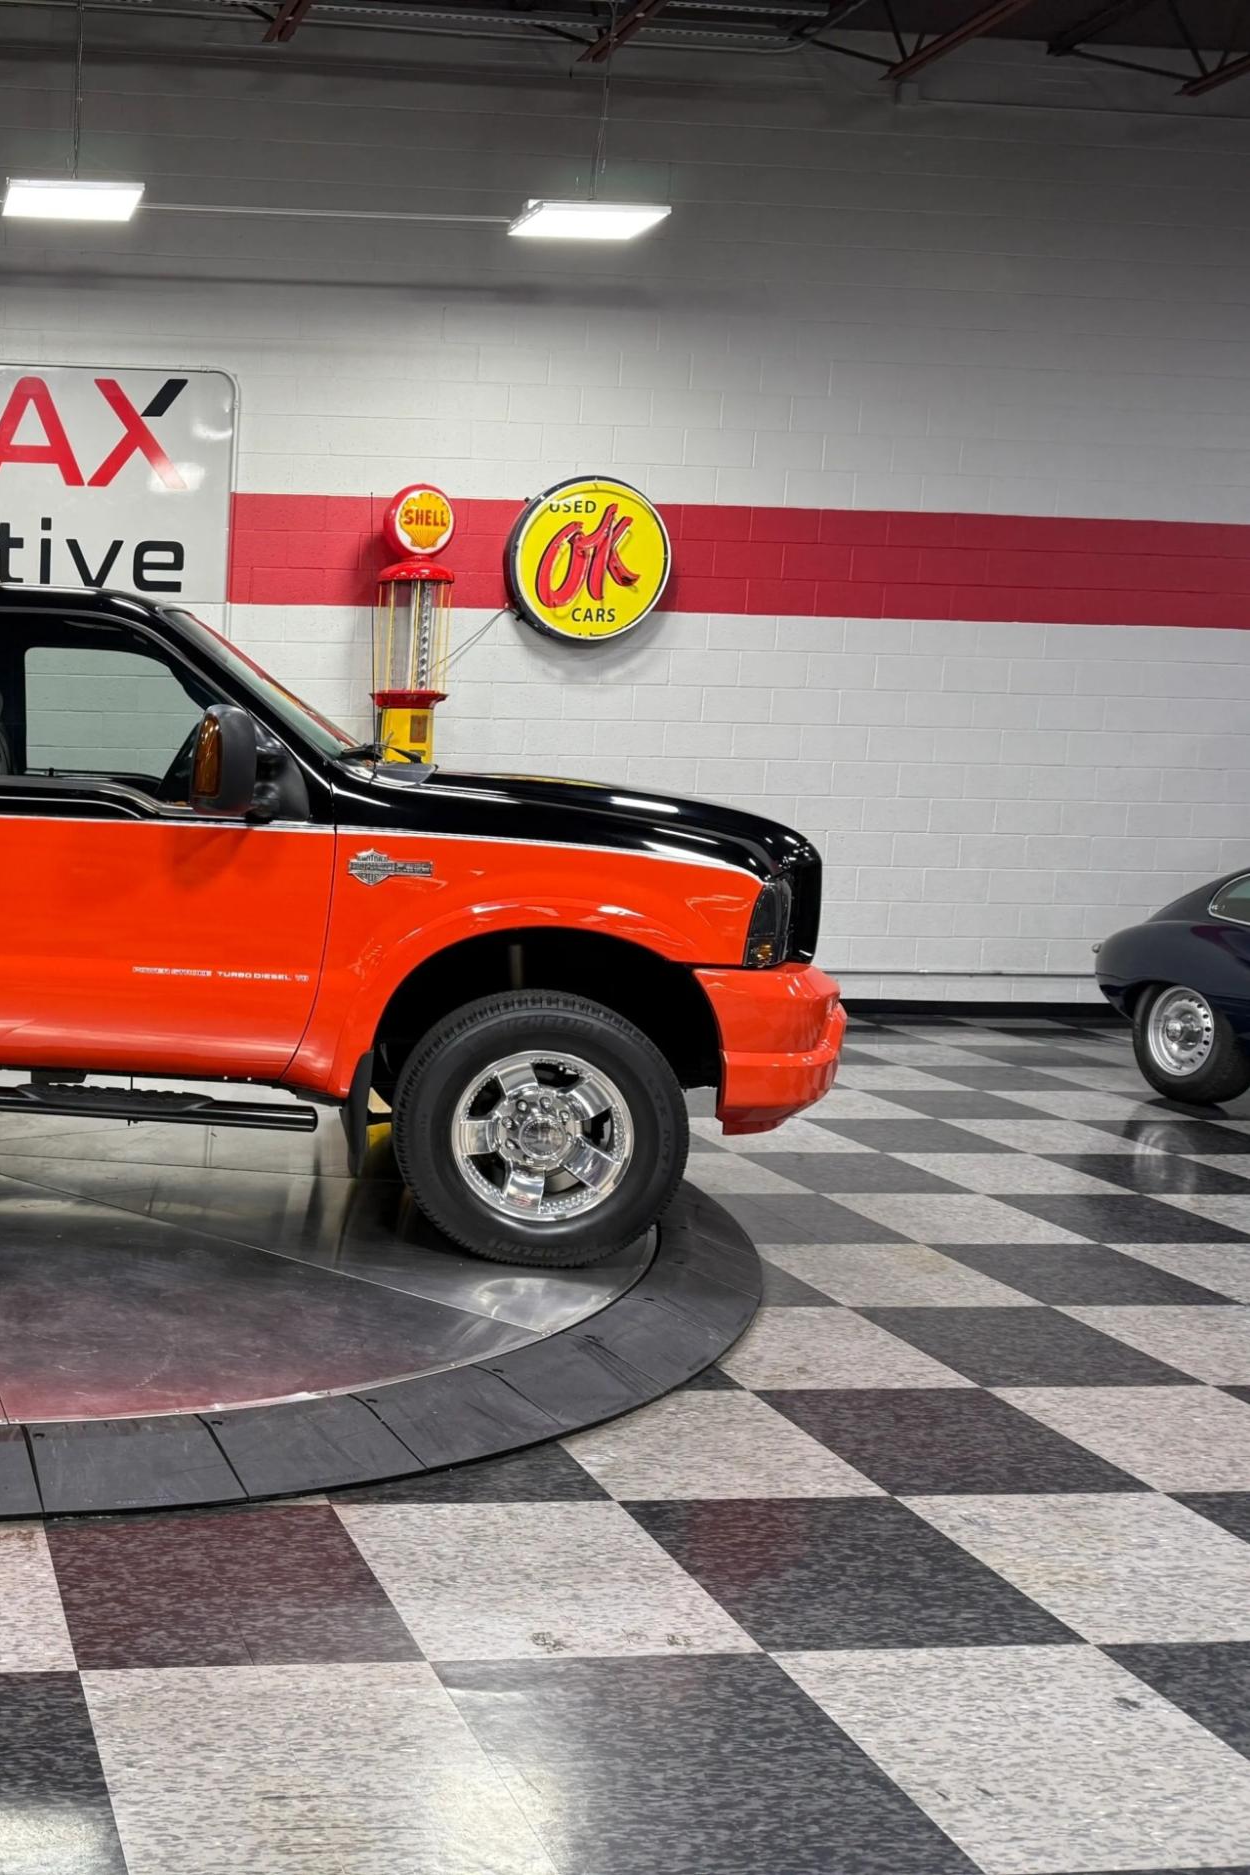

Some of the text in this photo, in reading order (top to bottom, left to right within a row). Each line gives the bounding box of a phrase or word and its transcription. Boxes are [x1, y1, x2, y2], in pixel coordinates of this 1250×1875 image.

[549, 500, 597, 514] USED
[402, 508, 447, 528] SHELL
[571, 608, 616, 622] CARS
[217, 971, 251, 979] TURBO
[253, 973, 292, 981] DIESEL
